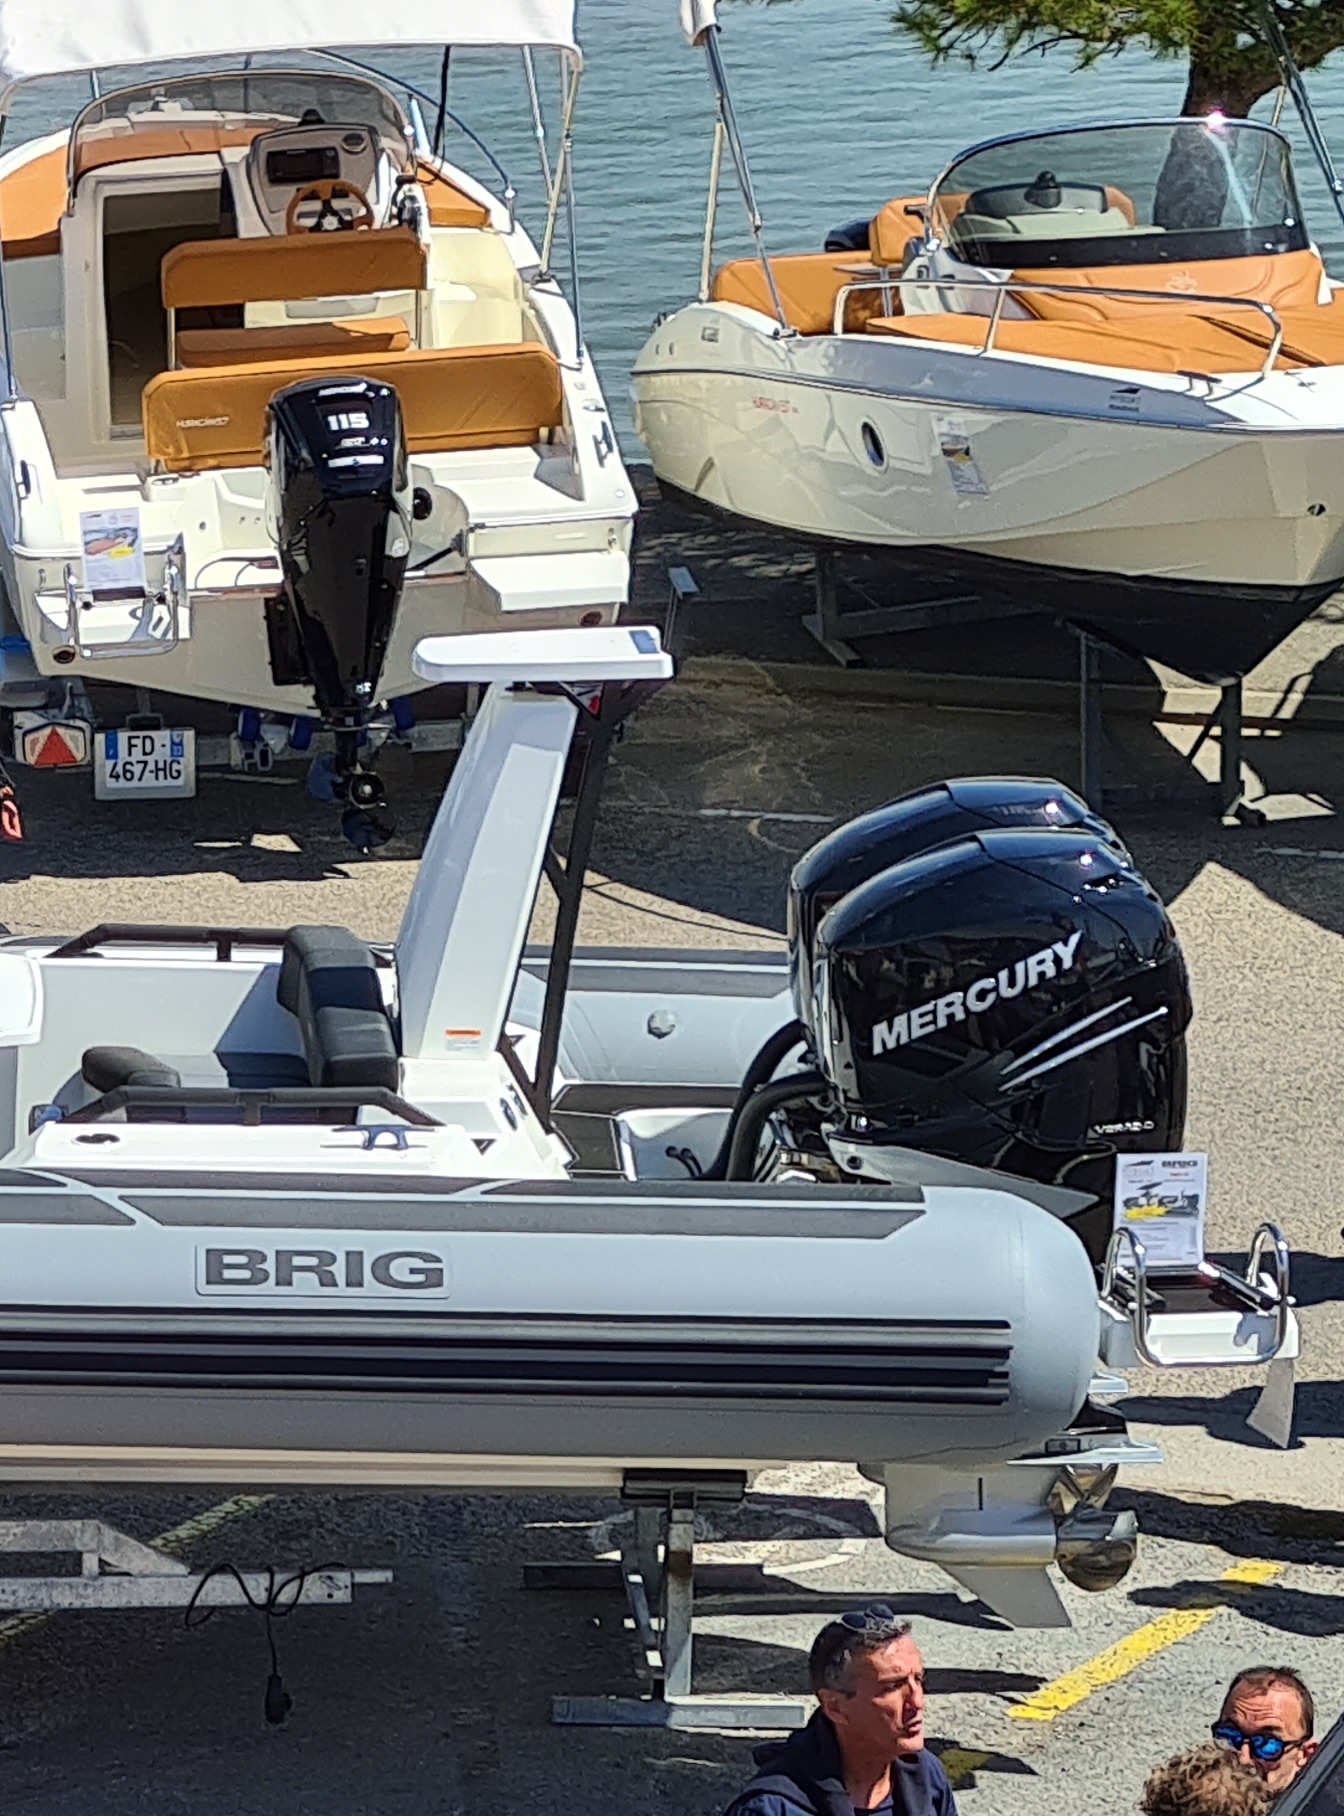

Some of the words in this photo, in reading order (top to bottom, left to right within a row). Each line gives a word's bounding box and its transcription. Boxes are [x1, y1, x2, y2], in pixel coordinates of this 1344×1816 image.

[327, 412, 370, 431] 115
[108, 759, 182, 782] 467-HG
[872, 929, 1084, 1056] MERCURY
[205, 1248, 444, 1290] BRIG
